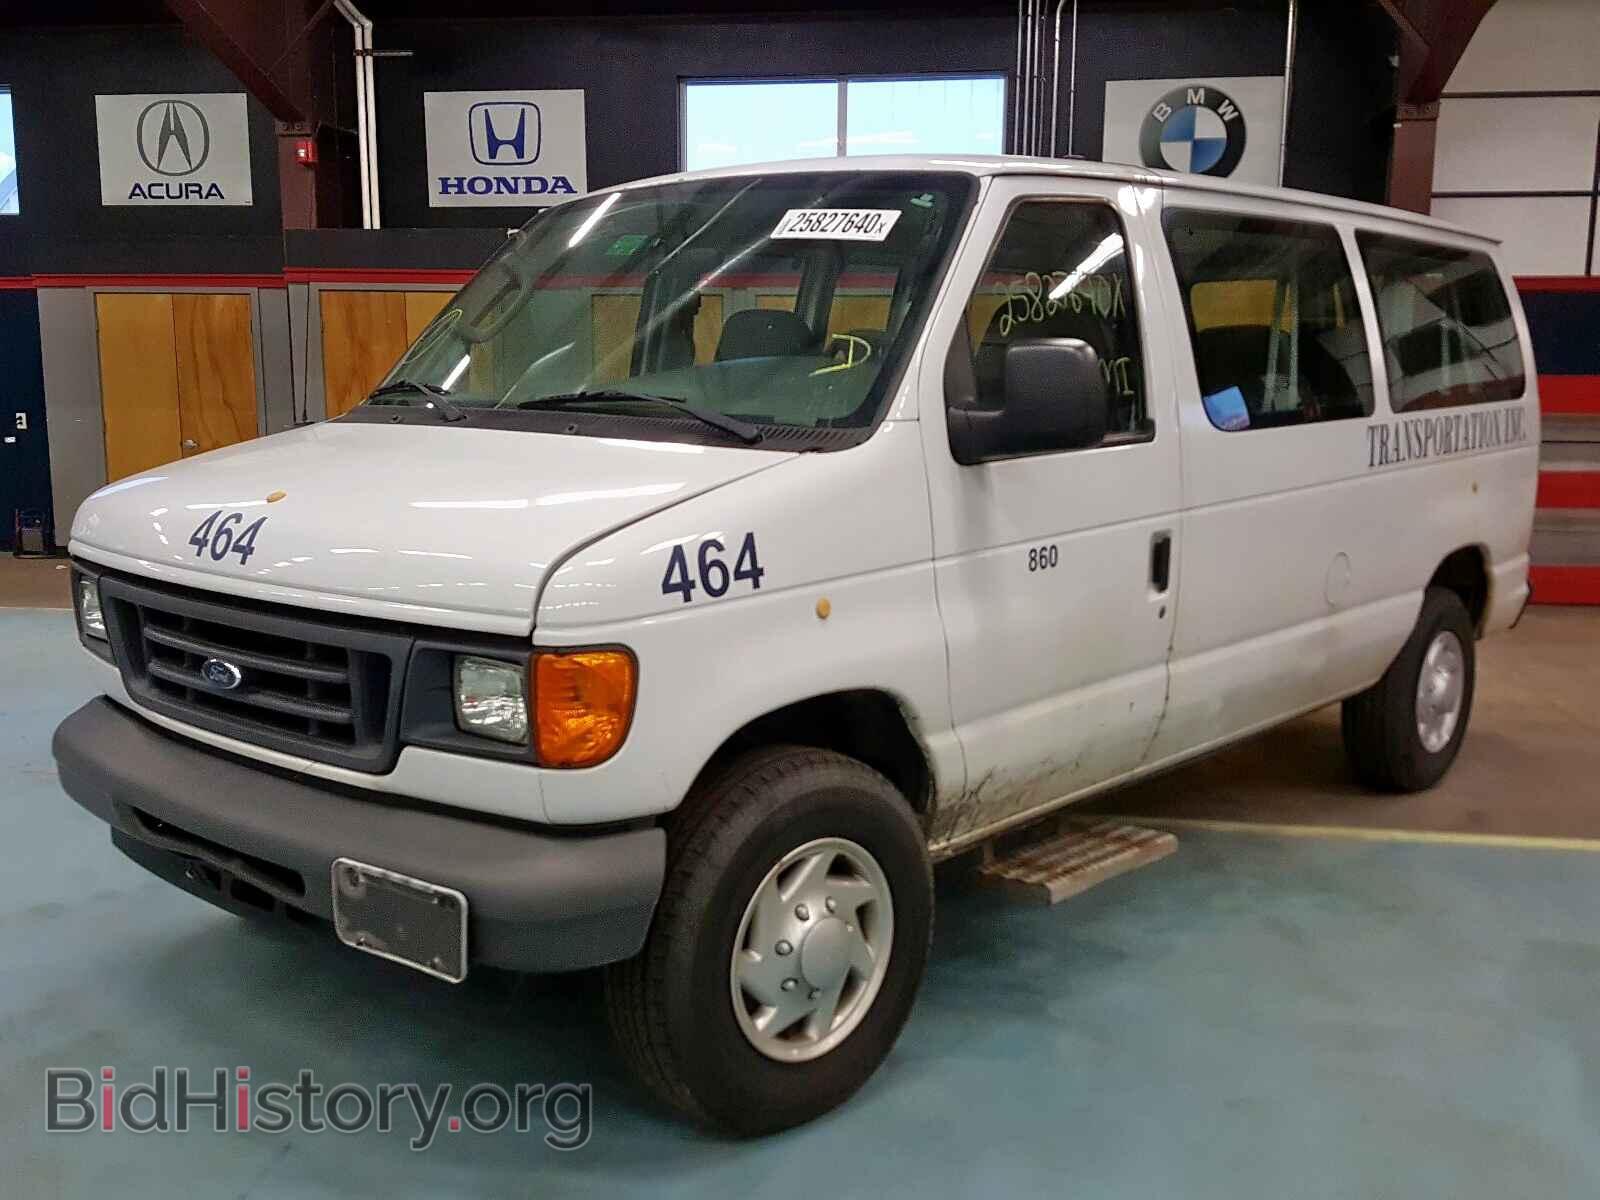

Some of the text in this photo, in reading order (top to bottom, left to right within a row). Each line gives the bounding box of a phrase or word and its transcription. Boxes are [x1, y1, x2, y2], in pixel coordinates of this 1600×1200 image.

[1152, 87, 1239, 122] BMW
[128, 182, 225, 200] ACURA
[438, 176, 578, 195] HONDA
[1367, 409, 1501, 467] TRANSPORTATION
[188, 510, 268, 565] 464
[662, 531, 764, 603] 464
[1029, 545, 1058, 572] 860
